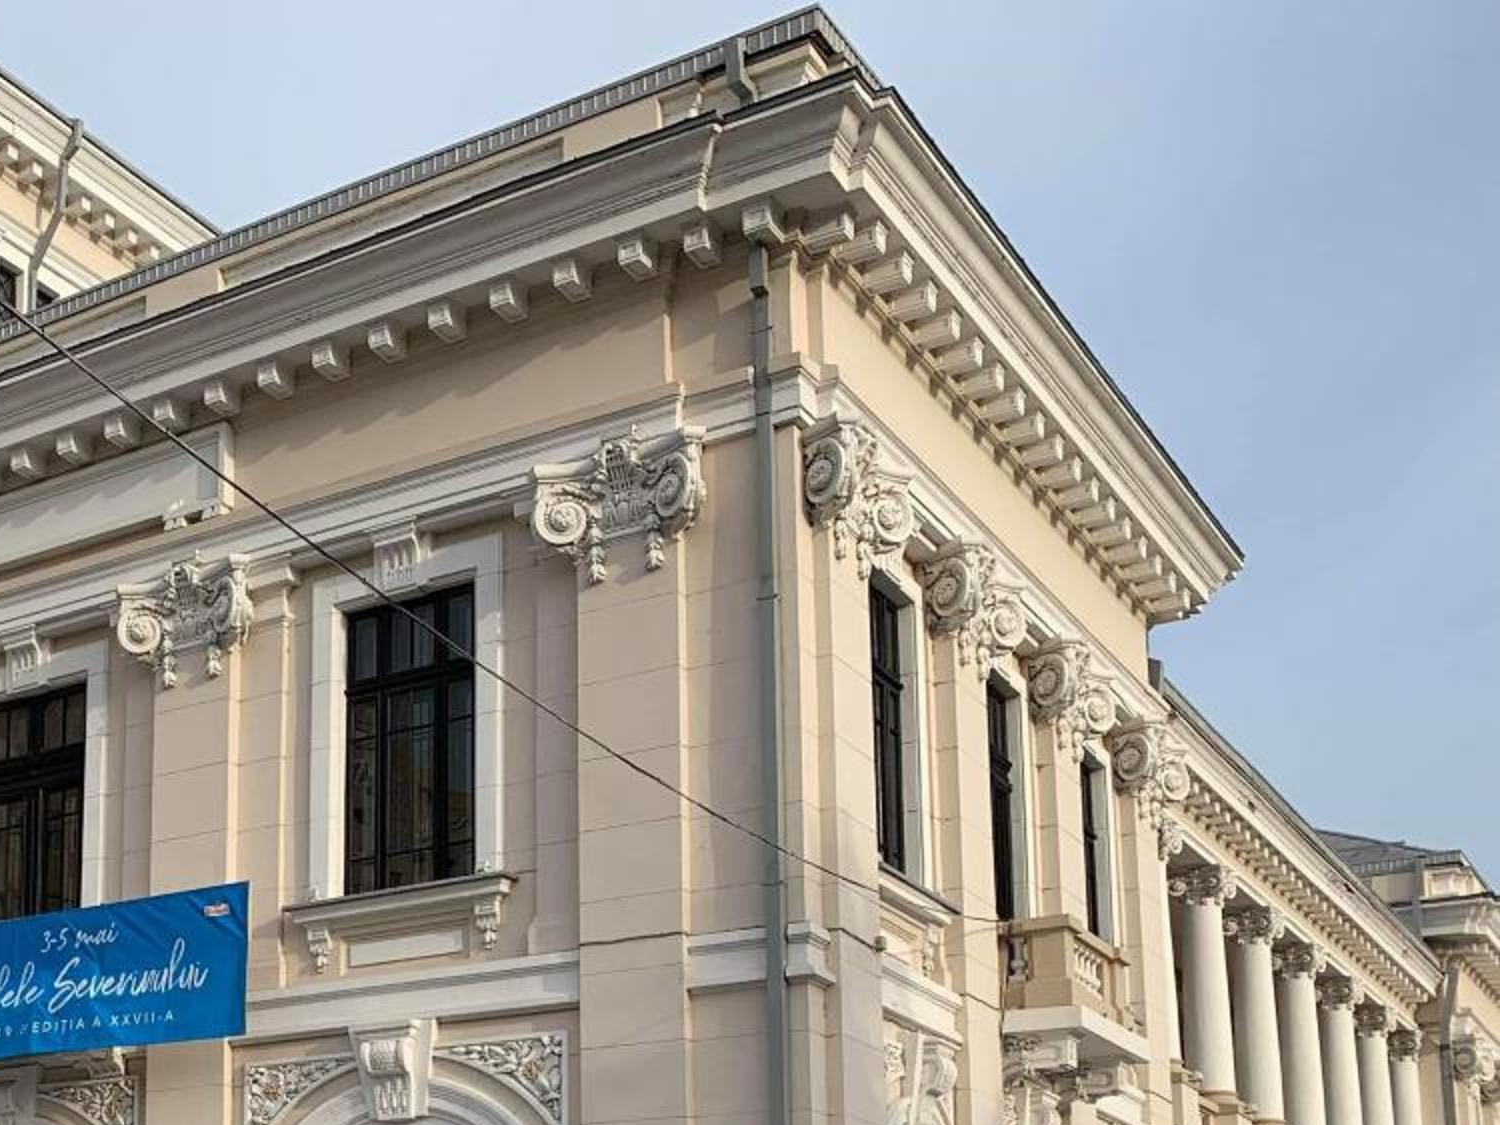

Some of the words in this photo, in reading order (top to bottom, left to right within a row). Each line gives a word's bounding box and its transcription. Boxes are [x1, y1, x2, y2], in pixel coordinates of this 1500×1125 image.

[40, 928, 68, 953] 3-5
[91, 1016, 101, 1028] A
[110, 1011, 175, 1027] XXVII-A
